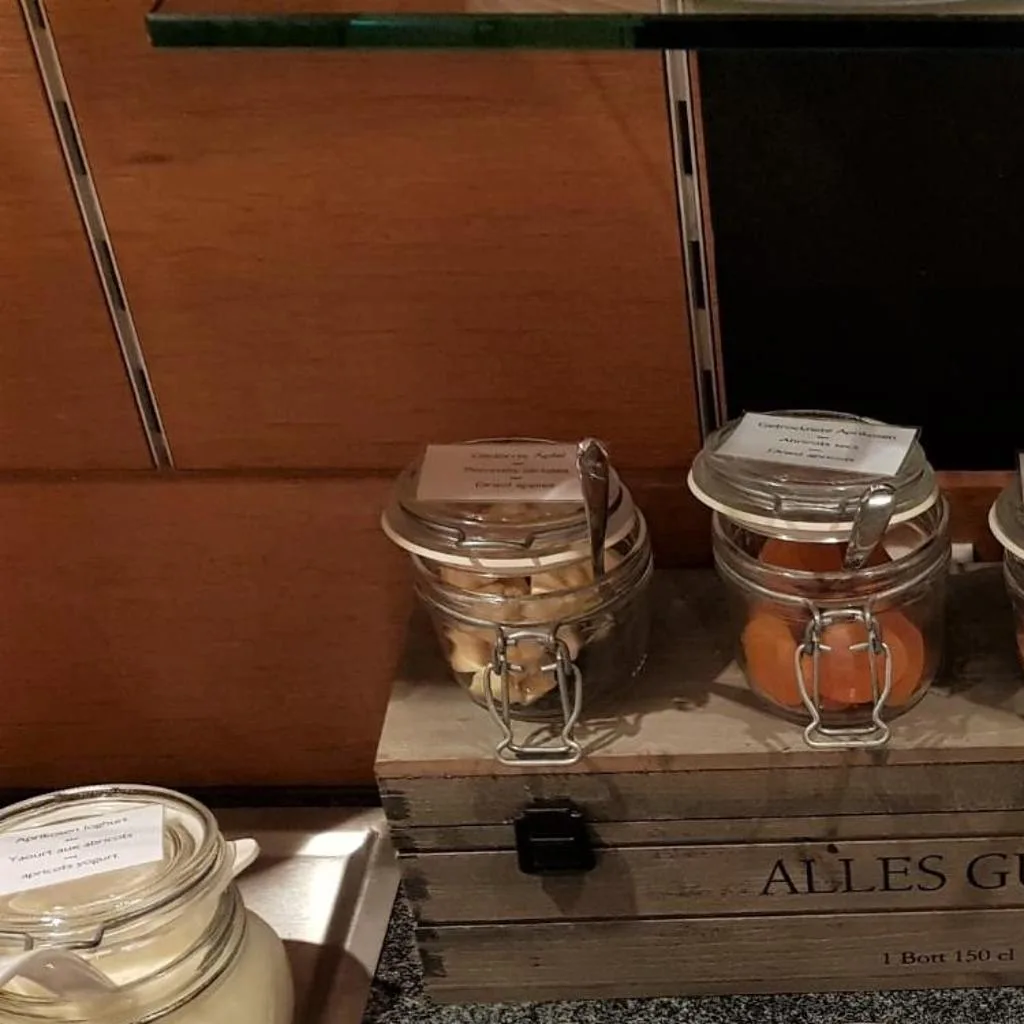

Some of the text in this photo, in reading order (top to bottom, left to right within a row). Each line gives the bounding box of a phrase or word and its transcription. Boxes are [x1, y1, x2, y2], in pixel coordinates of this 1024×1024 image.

[760, 854, 947, 896] ALLES
[883, 952, 891, 965] 1
[955, 949, 991, 963] 150
[998, 948, 1015, 962] cl
